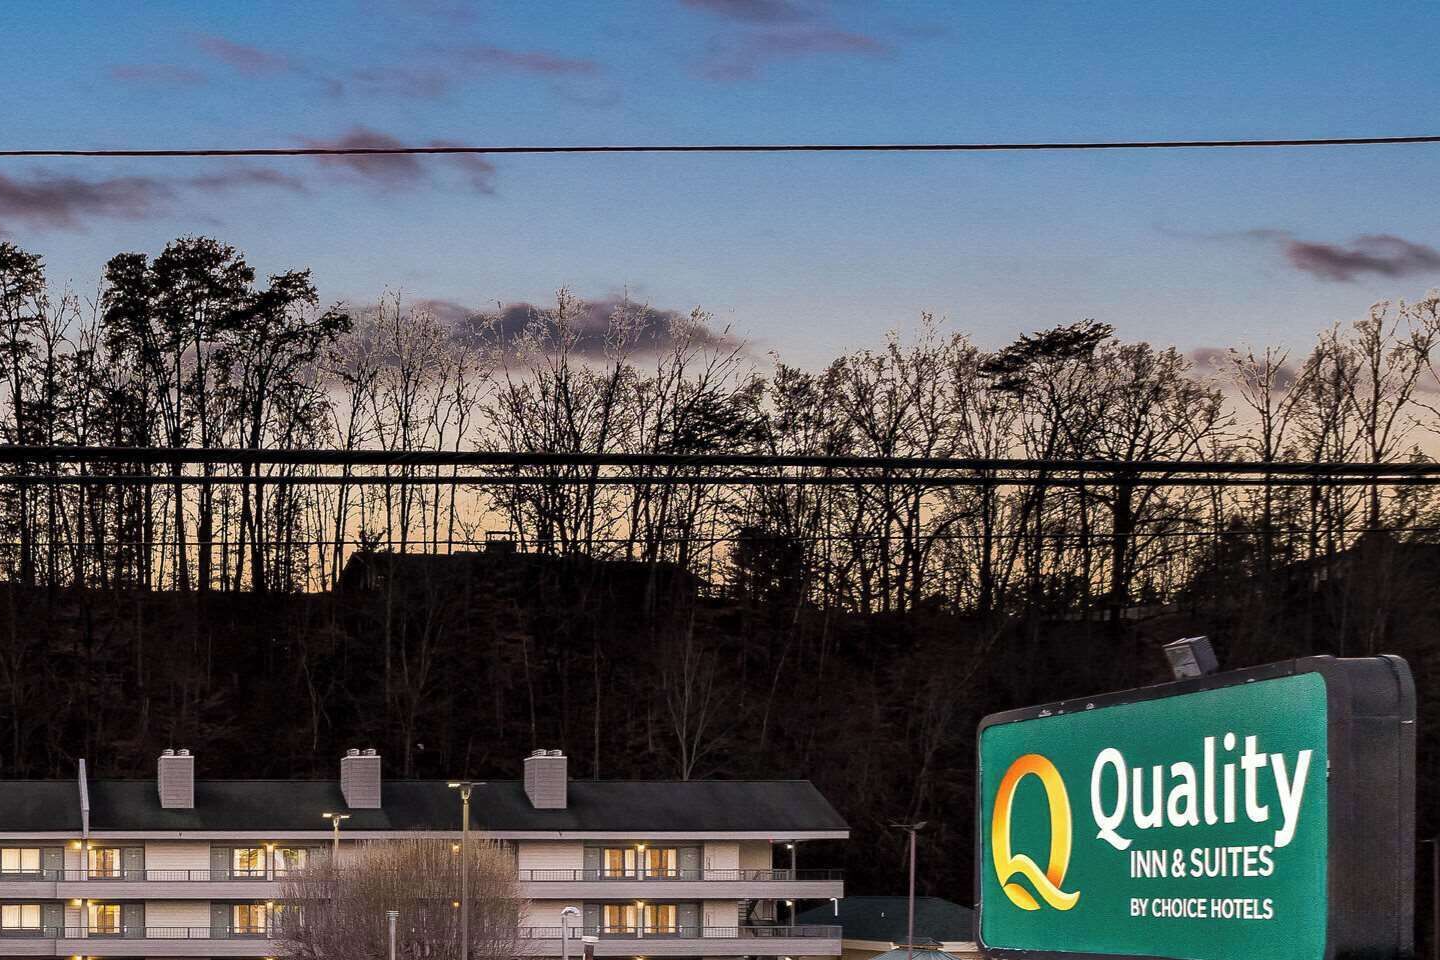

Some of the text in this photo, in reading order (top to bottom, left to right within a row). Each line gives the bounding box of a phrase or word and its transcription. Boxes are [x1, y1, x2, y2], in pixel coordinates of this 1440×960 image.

[1090, 732, 1313, 850] Quality
[991, 753, 1081, 911] Q
[1130, 845, 1274, 878] INN & SUITES
[1130, 898, 1273, 920] BY CHOICE HOTELS
